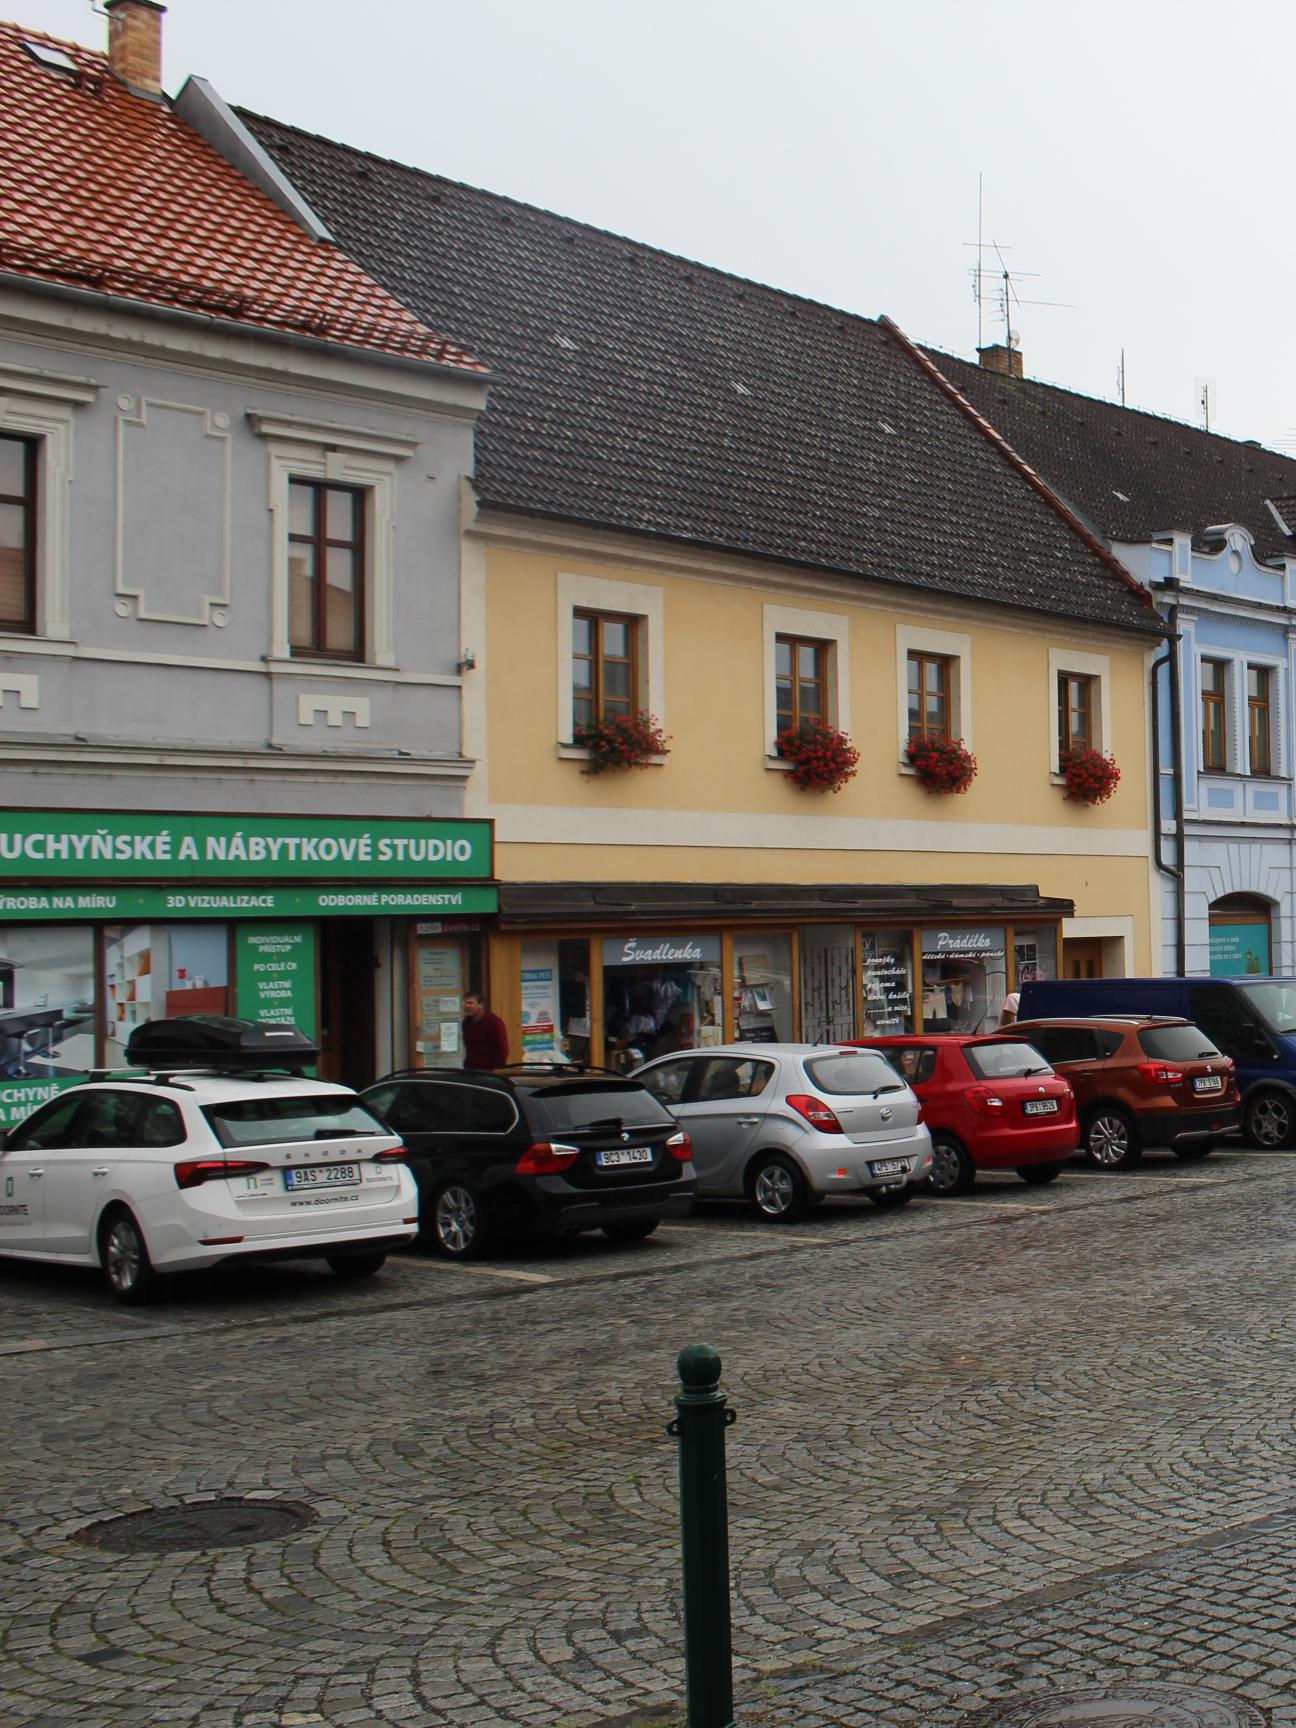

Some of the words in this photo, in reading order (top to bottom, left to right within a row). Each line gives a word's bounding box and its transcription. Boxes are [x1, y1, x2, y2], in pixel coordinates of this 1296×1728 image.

[178, 836, 199, 860] A
[206, 832, 372, 861] NÁBYTKOVÉ
[378, 839, 472, 862] STUDIO
[52, 897, 75, 908] NA
[77, 893, 116, 908] MÍRU
[166, 896, 186, 907] 3D
[187, 895, 274, 908] VIZUALIZACE
[318, 893, 379, 906] ODBORNÉ
[380, 892, 463, 905] PORADENSTVÍ
[247, 934, 303, 944] INDIVIDUÁLNÍ
[937, 932, 991, 950] Prádélko
[622, 938, 703, 961] Švadlenka
[258, 980, 293, 990] VLASTNÍ
[259, 1007, 294, 1017] VLASTNÍ
[626, 1149, 648, 1161] 1430
[295, 1169, 318, 1184] 9AS
[326, 1166, 355, 1181] 2288
